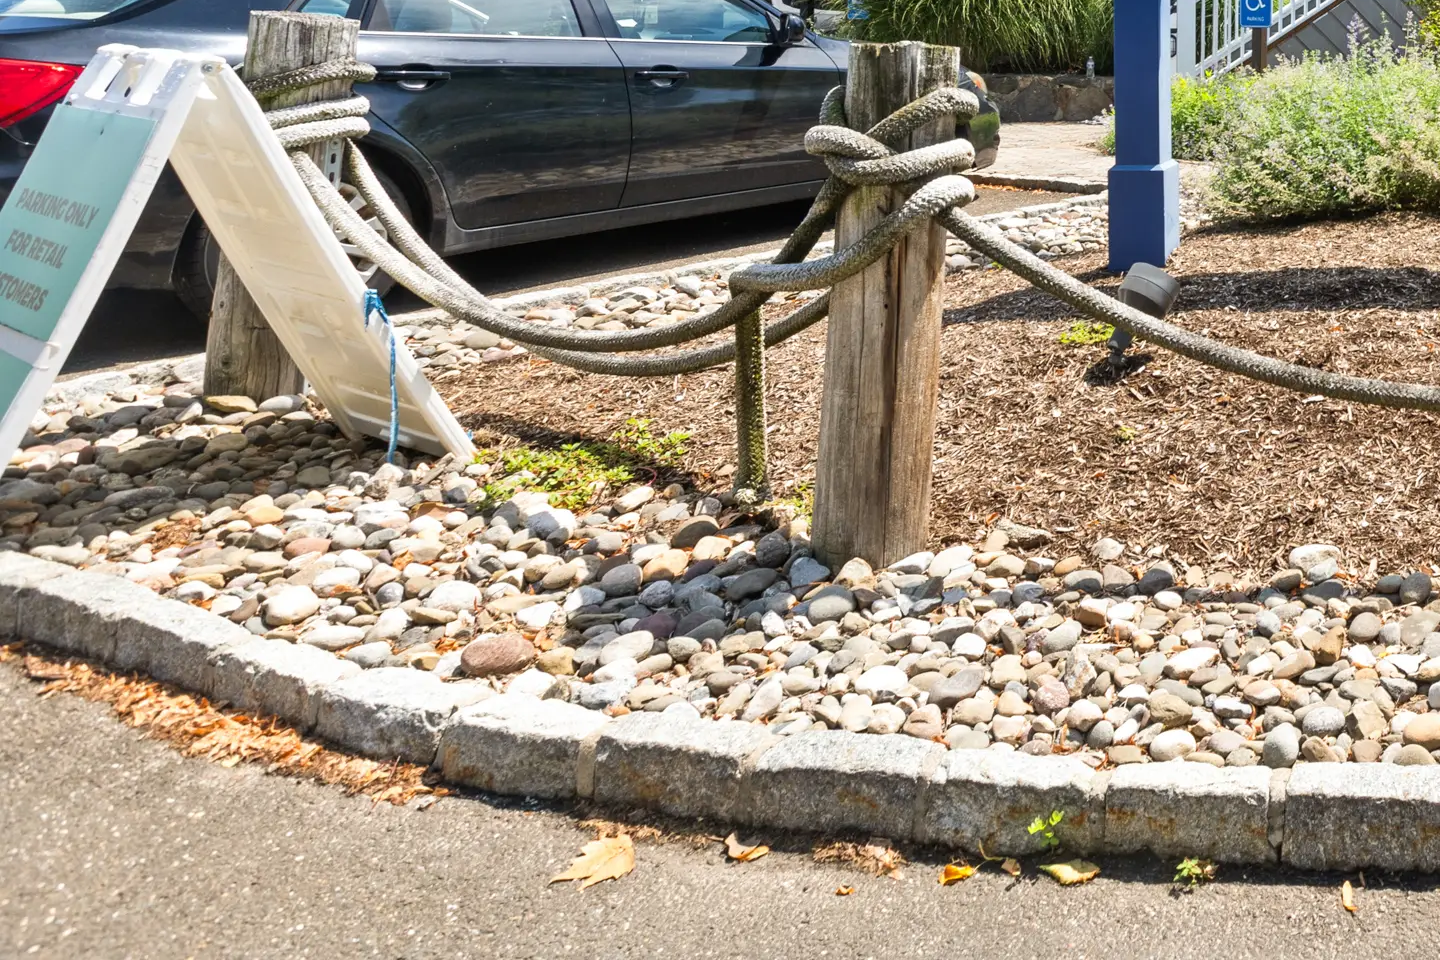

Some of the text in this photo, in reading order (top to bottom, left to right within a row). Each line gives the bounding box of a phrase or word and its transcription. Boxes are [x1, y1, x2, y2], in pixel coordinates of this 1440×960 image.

[14, 187, 100, 229] PARKING ONLY
[4, 228, 68, 269] FOR RETAIL
